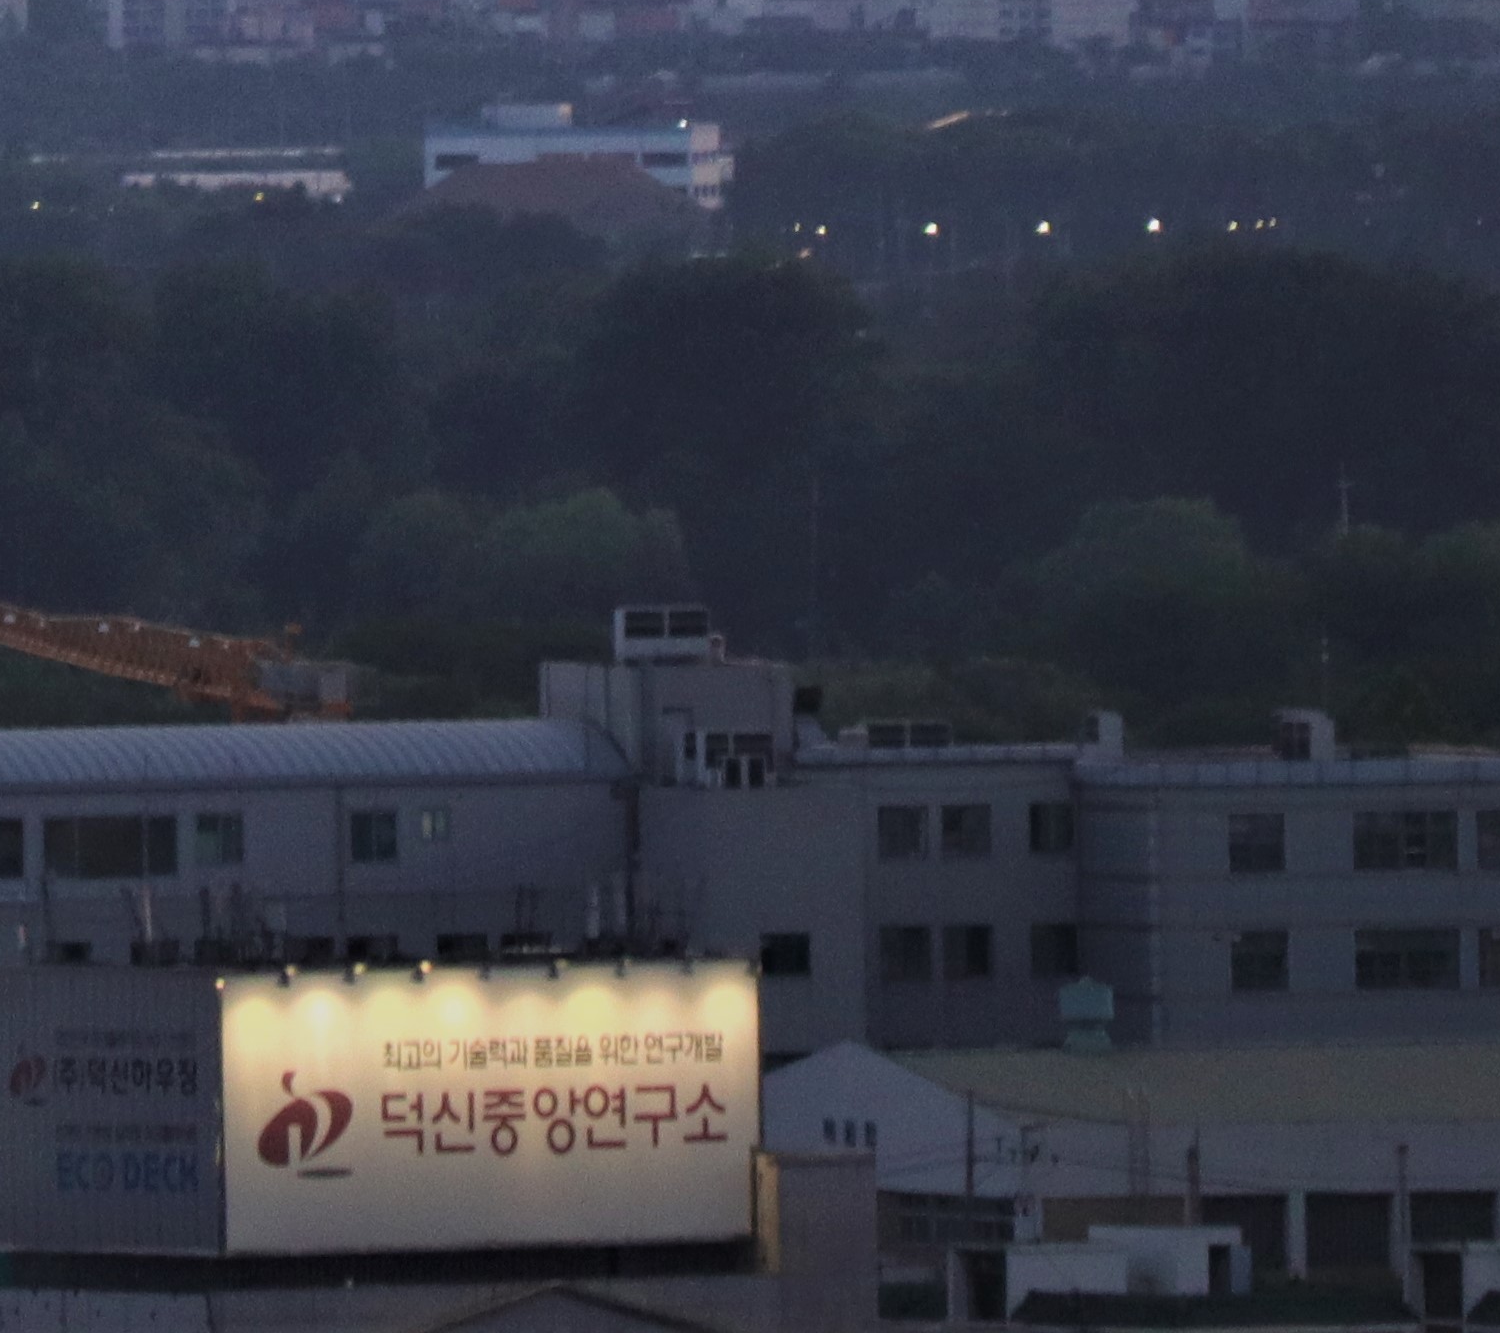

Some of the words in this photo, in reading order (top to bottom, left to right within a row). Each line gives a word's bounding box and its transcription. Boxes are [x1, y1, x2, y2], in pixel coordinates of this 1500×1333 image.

[382, 1040, 442, 1071] 최고의
[446, 1037, 529, 1071] 기술력과
[534, 1035, 593, 1069] 품질을
[598, 1034, 639, 1066] 위한
[643, 1031, 724, 1065] 연구개발
[380, 1082, 729, 1156] 덕신중앙연구소
[56, 1150, 115, 1192] ECO
[121, 1150, 200, 1193] DECK
